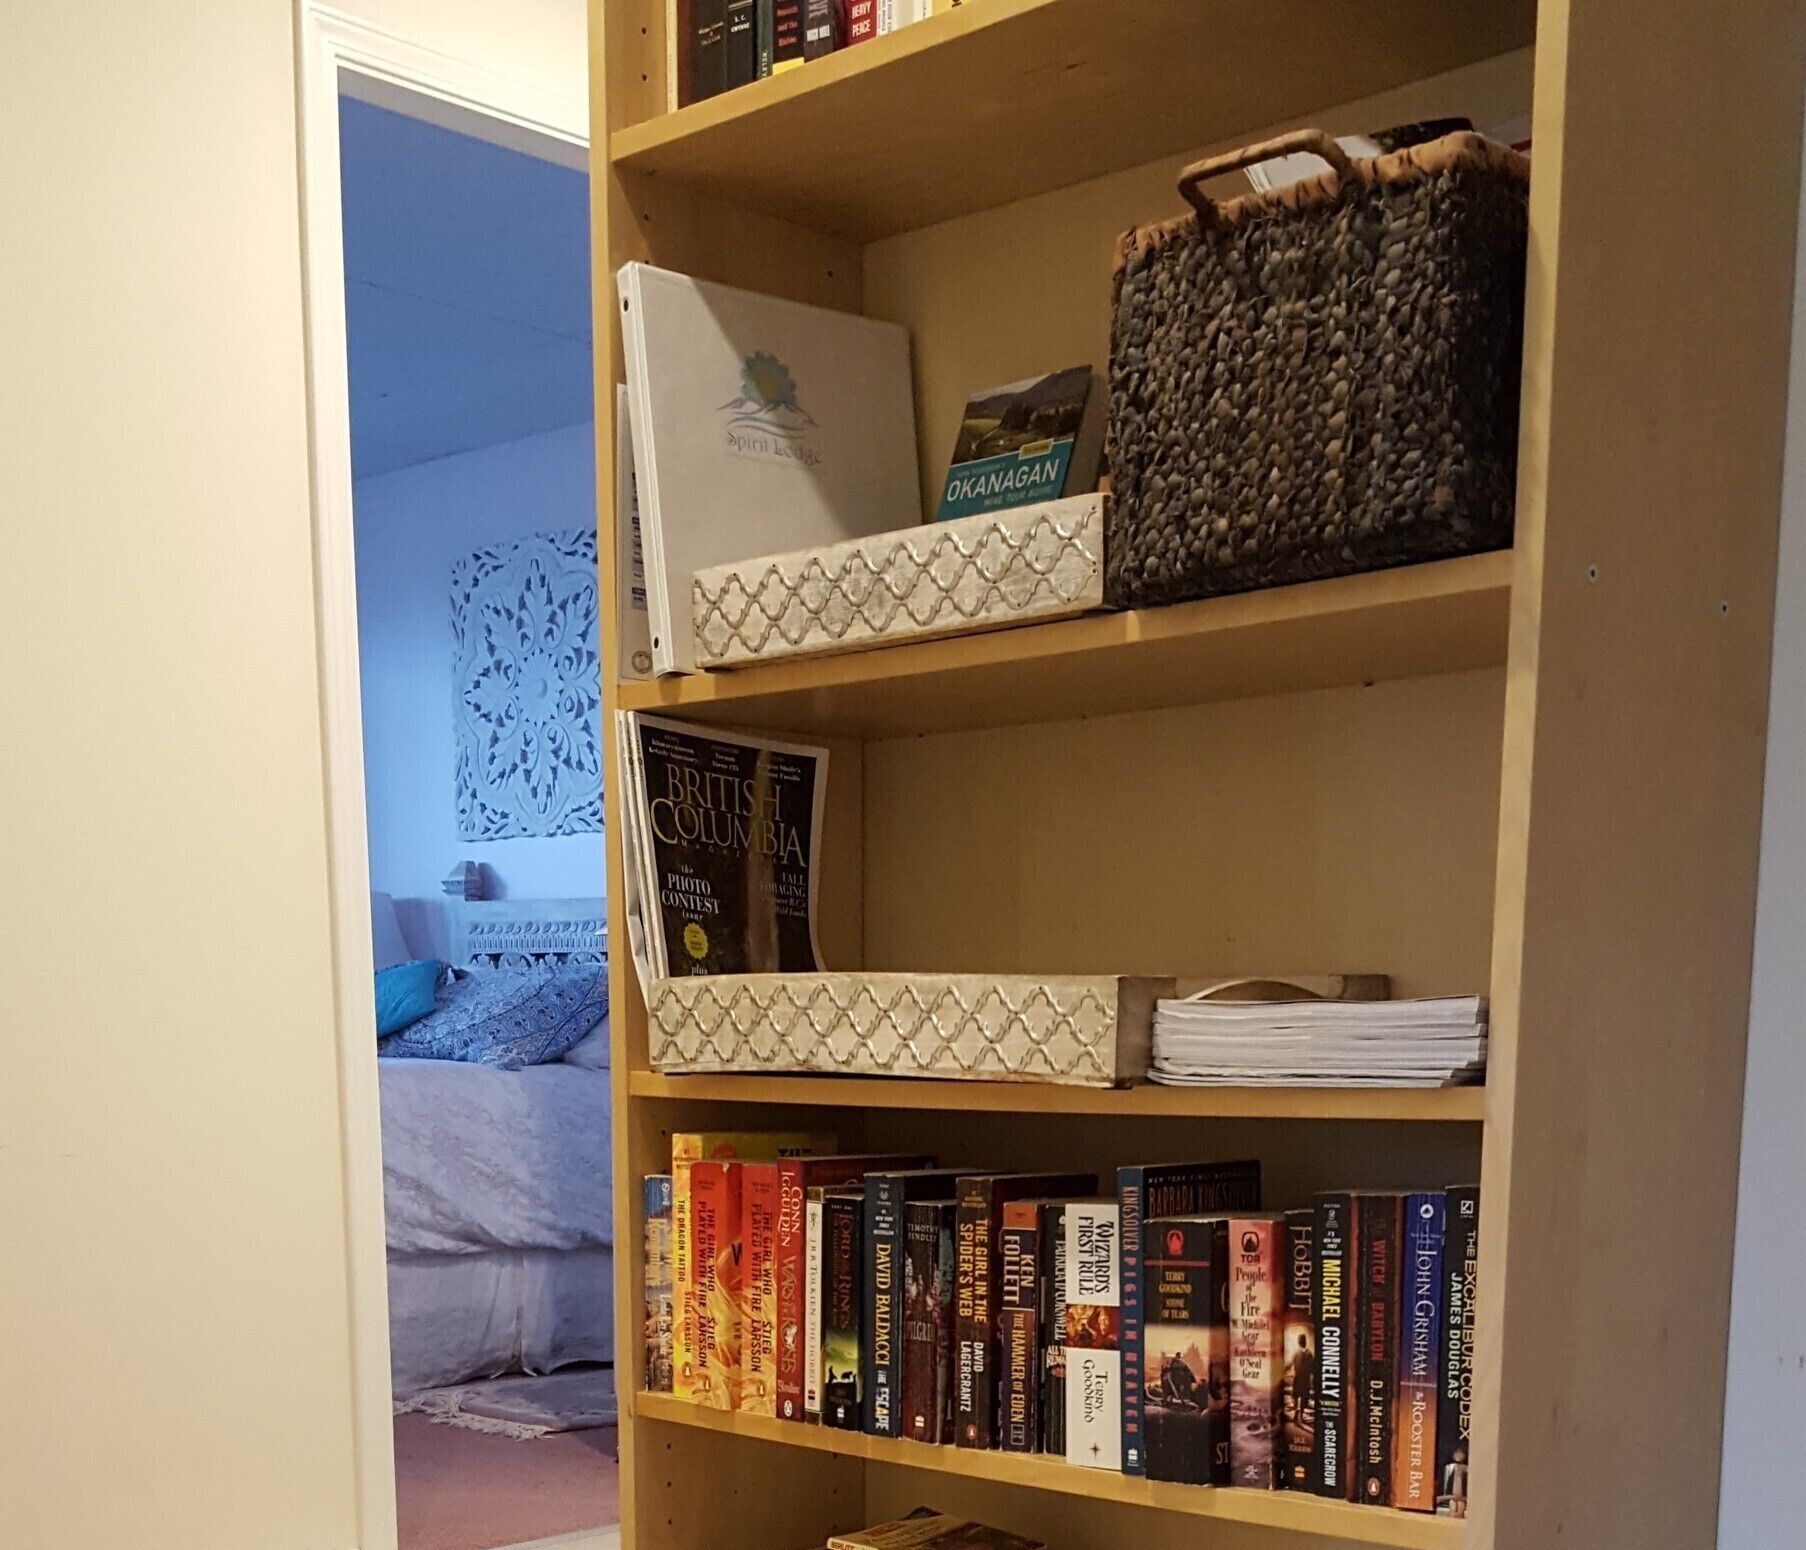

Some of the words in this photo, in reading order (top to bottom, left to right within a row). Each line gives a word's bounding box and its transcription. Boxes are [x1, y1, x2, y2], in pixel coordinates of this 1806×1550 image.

[851, 1, 872, 20] HEAVY
[852, 19, 871, 38] PEACE
[726, 431, 768, 451] Spirit
[774, 439, 822, 465] Lodge
[947, 459, 1059, 502] OKANAGAN
[666, 763, 782, 821] BRITISH
[650, 798, 807, 867] COLUMBIA
[667, 873, 711, 895] PHOTO
[782, 872, 806, 885] FALL
[662, 889, 720, 914] CONTEST
[778, 1172, 795, 1247] IGGULDEN
[791, 1187, 803, 1233] CONN
[1150, 1185, 1194, 1217] BARBARA
[698, 1201, 706, 1242] PLAYED
[707, 1209, 715, 1230] THE
[752, 1204, 762, 1249] PLAYED
[763, 1212, 772, 1232] THE
[907, 1223, 938, 1233] TIMOTHY
[975, 1218, 988, 1242] THE
[1123, 1186, 1139, 1251] KINGSOLVER
[707, 1235, 715, 1261] GIRL
[763, 1236, 772, 1262] GIRL
[1078, 1216, 1094, 1257] FIRST
[1466, 1231, 1476, 1257] THE
[698, 1249, 707, 1279] WITH
[751, 1252, 762, 1282] WITH
[876, 1243, 892, 1289] DAVID
[960, 1223, 974, 1284] SPIDER'S
[975, 1245, 988, 1277] GIRL
[1004, 1235, 1020, 1304] FOLLETT
[1094, 1221, 1114, 1294] WIZARD'S
[1241, 1254, 1261, 1263] TOR
[1372, 1239, 1386, 1284] WITCH
[707, 1263, 716, 1292] WHO
[763, 1268, 773, 1296] WHO
[1021, 1255, 1035, 1287] KEN
[1078, 1261, 1094, 1296] RULE
[1124, 1257, 1137, 1307] PIGS
[1165, 1272, 1185, 1280] TERRY
[1236, 1266, 1266, 1286] People
[1290, 1226, 1312, 1315] HOBBIT
[1416, 1251, 1437, 1295] JOHN
[699, 1283, 707, 1308] FIRE
[751, 1286, 762, 1312] FIRE
[810, 1264, 818, 1316] TOLKIEN
[959, 1287, 973, 1317] WEB
[974, 1281, 988, 1295] IN
[1159, 1284, 1192, 1294] GOODKIND
[1245, 1293, 1257, 1303] the
[1322, 1259, 1341, 1322] MICHAEL
[1449, 1273, 1462, 1325] JAMES
[974, 1298, 987, 1323] THE
[1014, 1313, 1025, 1329] THE
[1171, 1310, 1189, 1319] TEARS
[1240, 1302, 1260, 1317] Fire
[1460, 1260, 1477, 1368] EXCALIBUR
[699, 1315, 707, 1368] LARSSON
[707, 1317, 715, 1350] STIEG
[762, 1321, 771, 1355] STIEG
[875, 1294, 891, 1366] BALDACCI
[1125, 1319, 1137, 1340] IN
[1370, 1302, 1385, 1361] BABYLON
[1412, 1300, 1436, 1376] GRISHAM
[751, 1320, 762, 1372] LARSSON
[973, 1342, 984, 1372] DAVID
[1011, 1330, 1026, 1380] HAMMER
[1046, 1345, 1059, 1355] ALL
[1321, 1326, 1341, 1398] CONNELLY
[878, 1370, 887, 1384] THE
[960, 1341, 971, 1412] LAGERCRANTZ
[1239, 1358, 1261, 1369] O'Neal
[1242, 1368, 1259, 1380] Gear
[1447, 1330, 1461, 1400] DOUGLAS
[1013, 1383, 1025, 1392] OF
[1125, 1352, 1138, 1433] HEAVEN
[875, 1388, 890, 1431] ESCAPE
[1011, 1394, 1025, 1422] EDEN
[1459, 1375, 1473, 1440] CODEX
[1411, 1401, 1427, 1466] ROOSTER
[1324, 1429, 1336, 1487] SCARECROW
[1409, 1472, 1423, 1498] BAR
